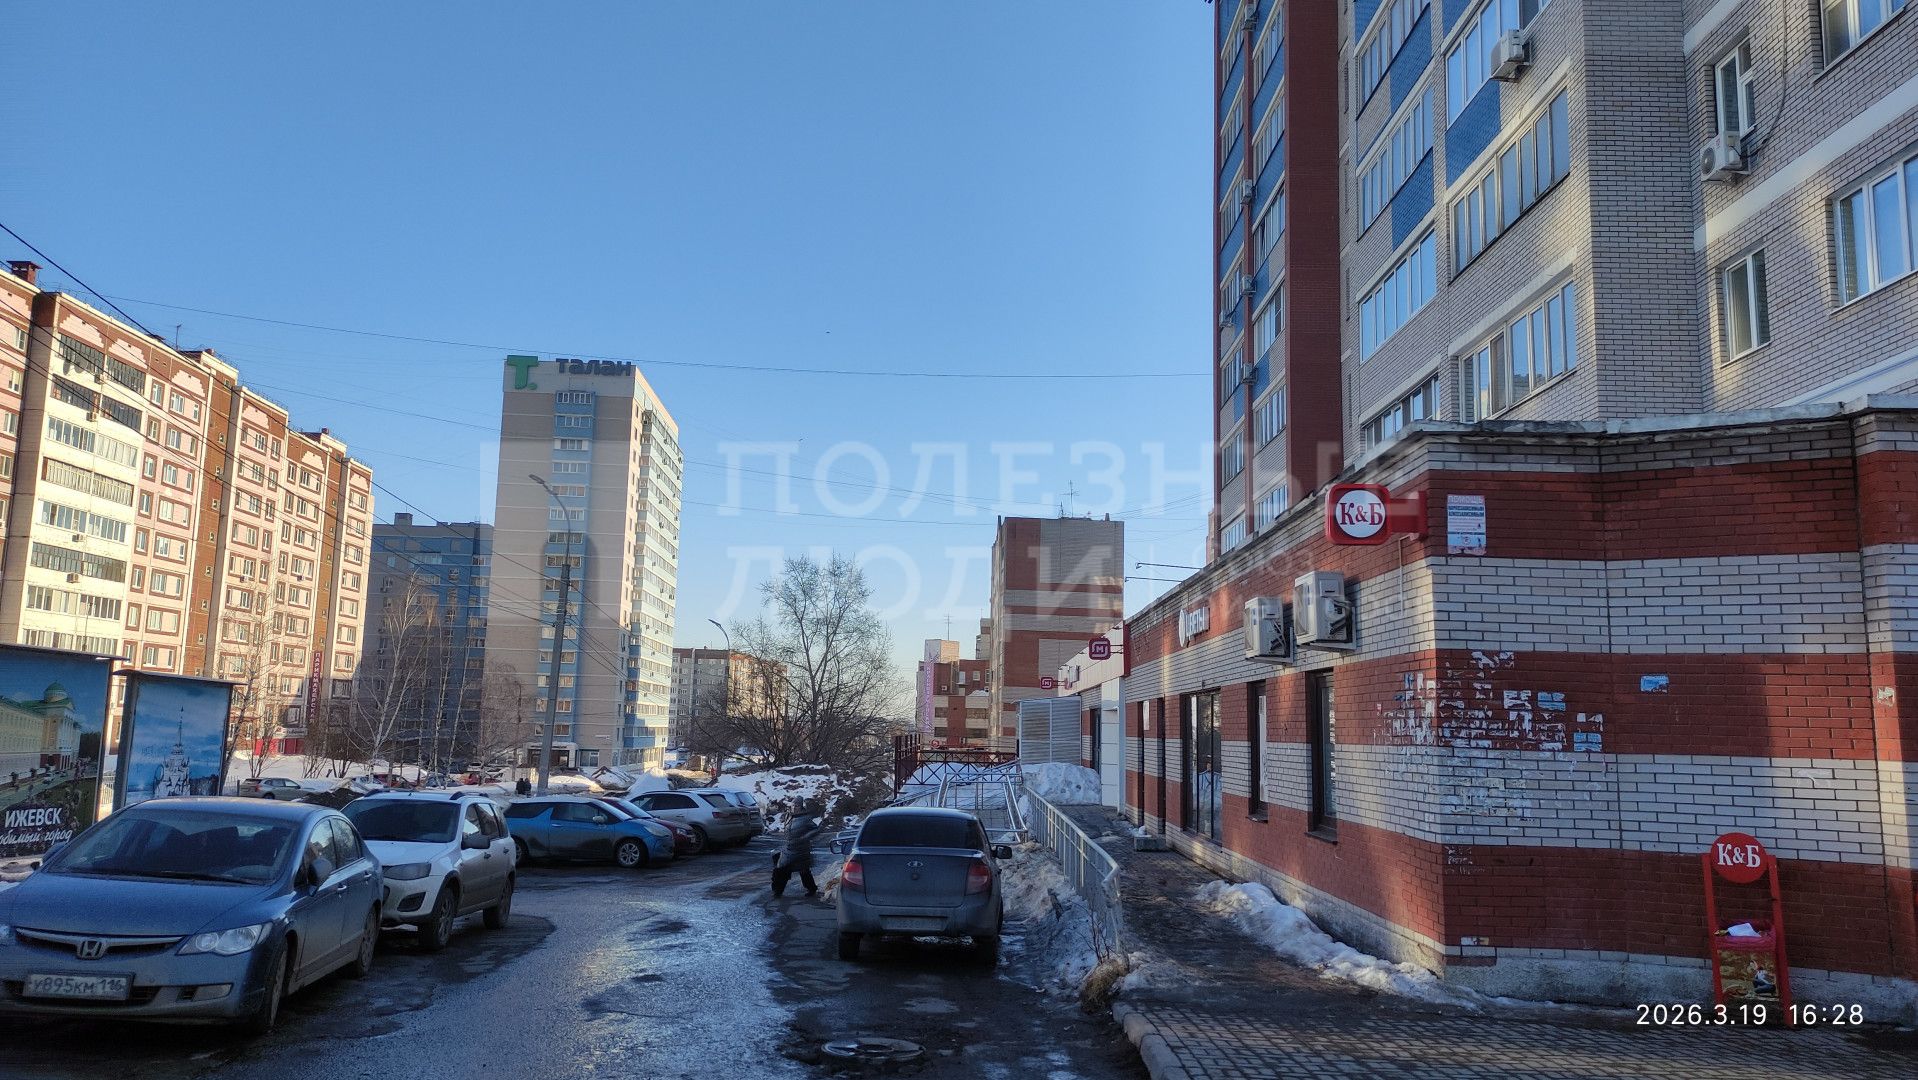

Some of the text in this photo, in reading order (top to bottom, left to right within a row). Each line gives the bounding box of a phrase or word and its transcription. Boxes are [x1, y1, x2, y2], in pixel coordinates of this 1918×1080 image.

[1339, 502, 1384, 525] К&Б
[4, 807, 62, 828] ИЖЕВСК
[43, 828, 73, 846] город
[1717, 843, 1761, 868] К&Б
